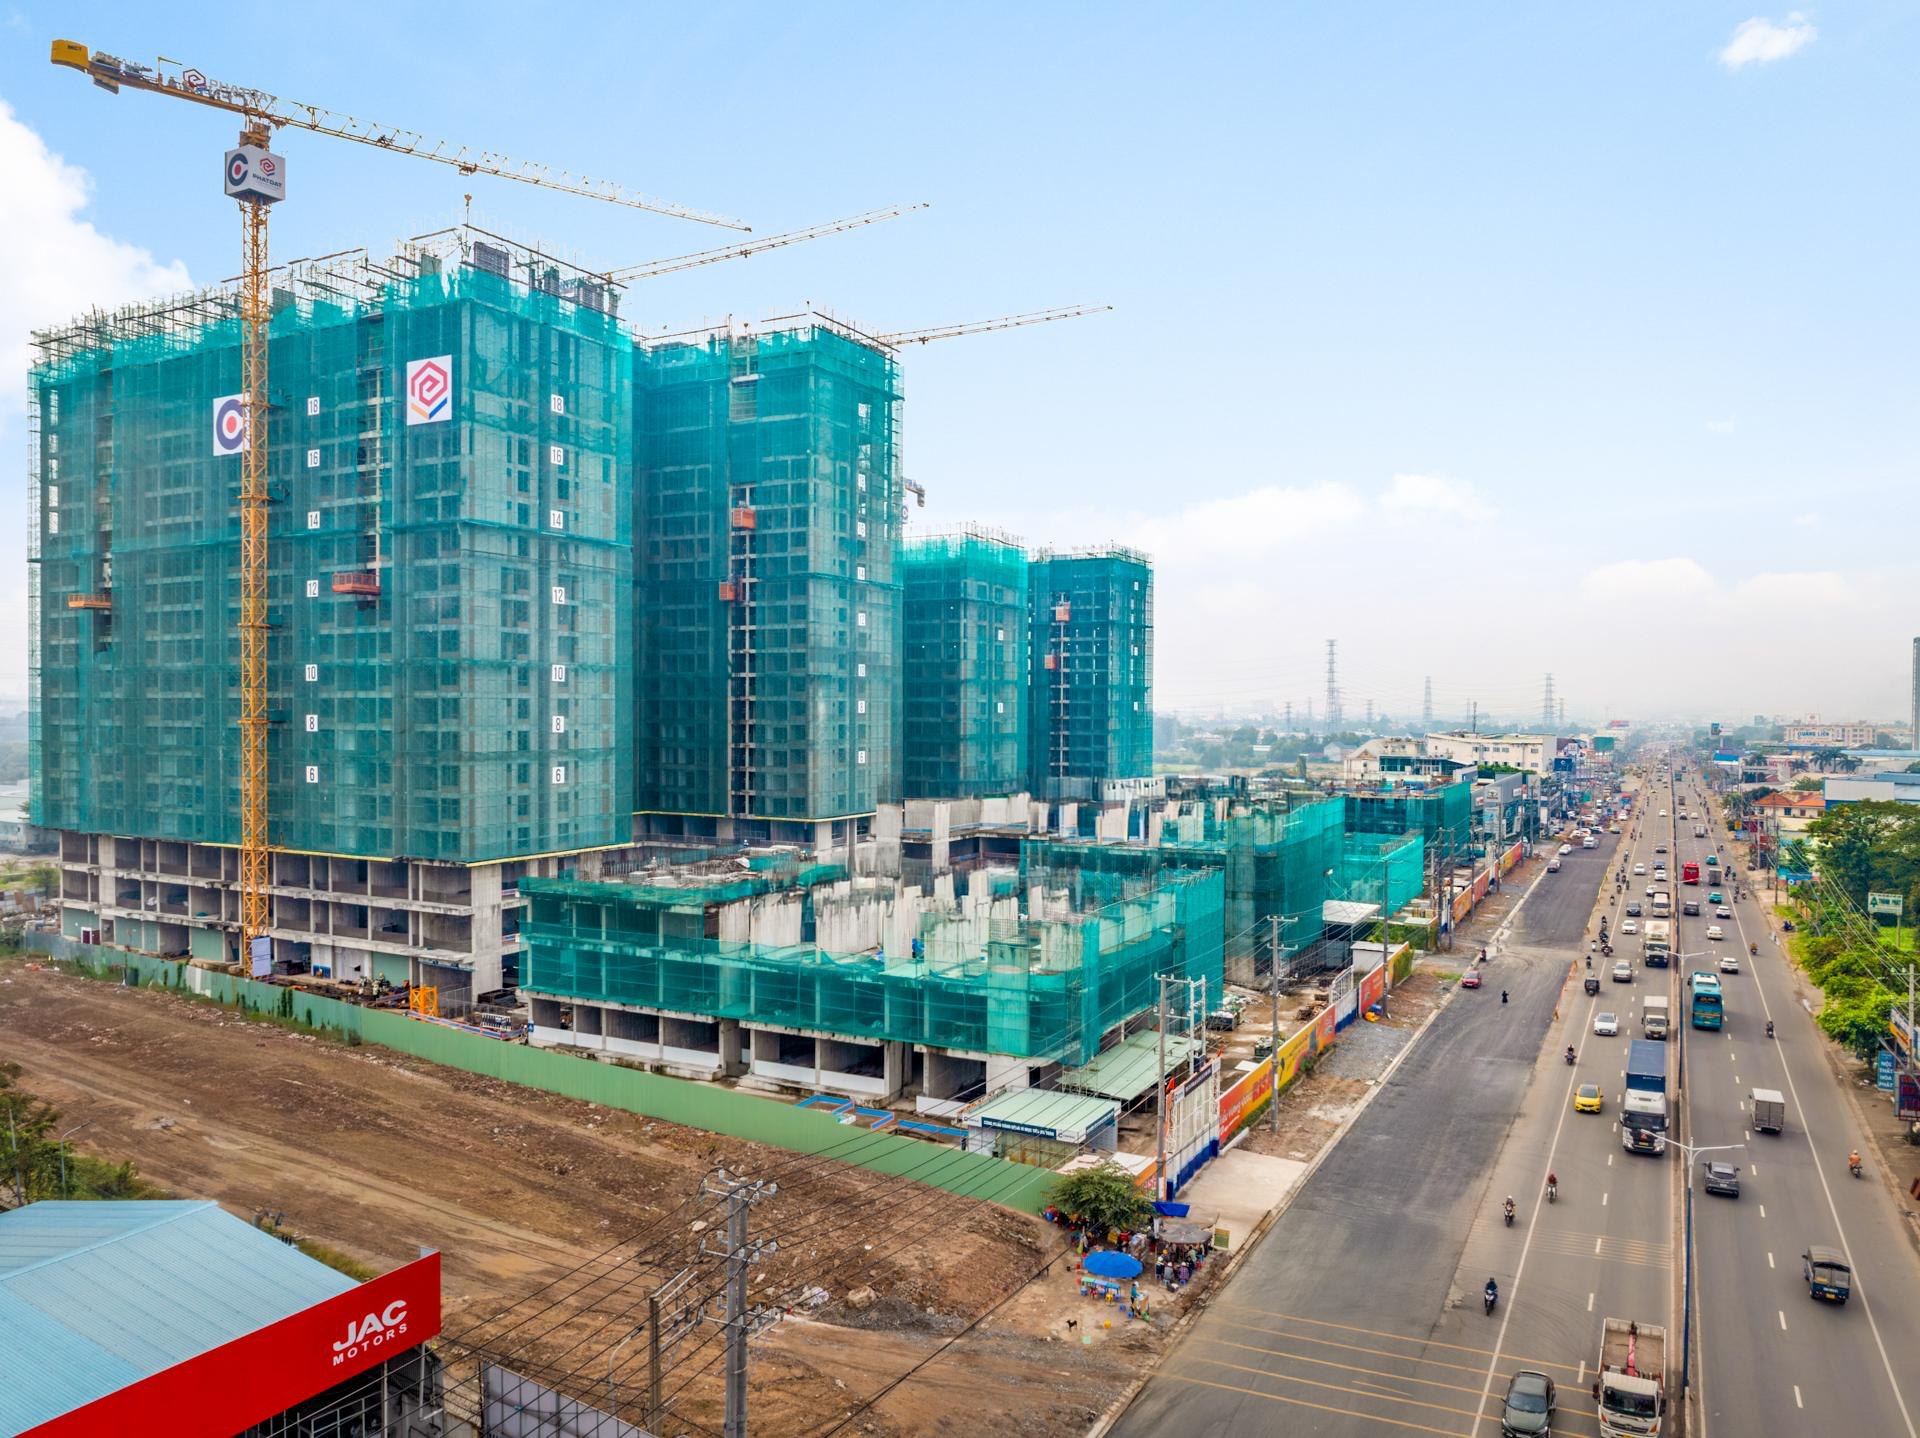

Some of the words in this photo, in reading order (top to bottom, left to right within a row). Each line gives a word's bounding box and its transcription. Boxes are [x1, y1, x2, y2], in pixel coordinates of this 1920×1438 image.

[309, 399, 318, 414] 18
[553, 397, 562, 413] 18
[309, 451, 318, 466] 16
[552, 448, 562, 463] 16
[309, 513, 318, 527] 14
[552, 512, 562, 527] 14
[308, 581, 318, 596] 12
[553, 588, 563, 603] 12
[307, 665, 317, 680] 10
[553, 666, 564, 681] 10
[333, 1300, 407, 1352] JAC
[333, 1323, 407, 1366] MOTORS
